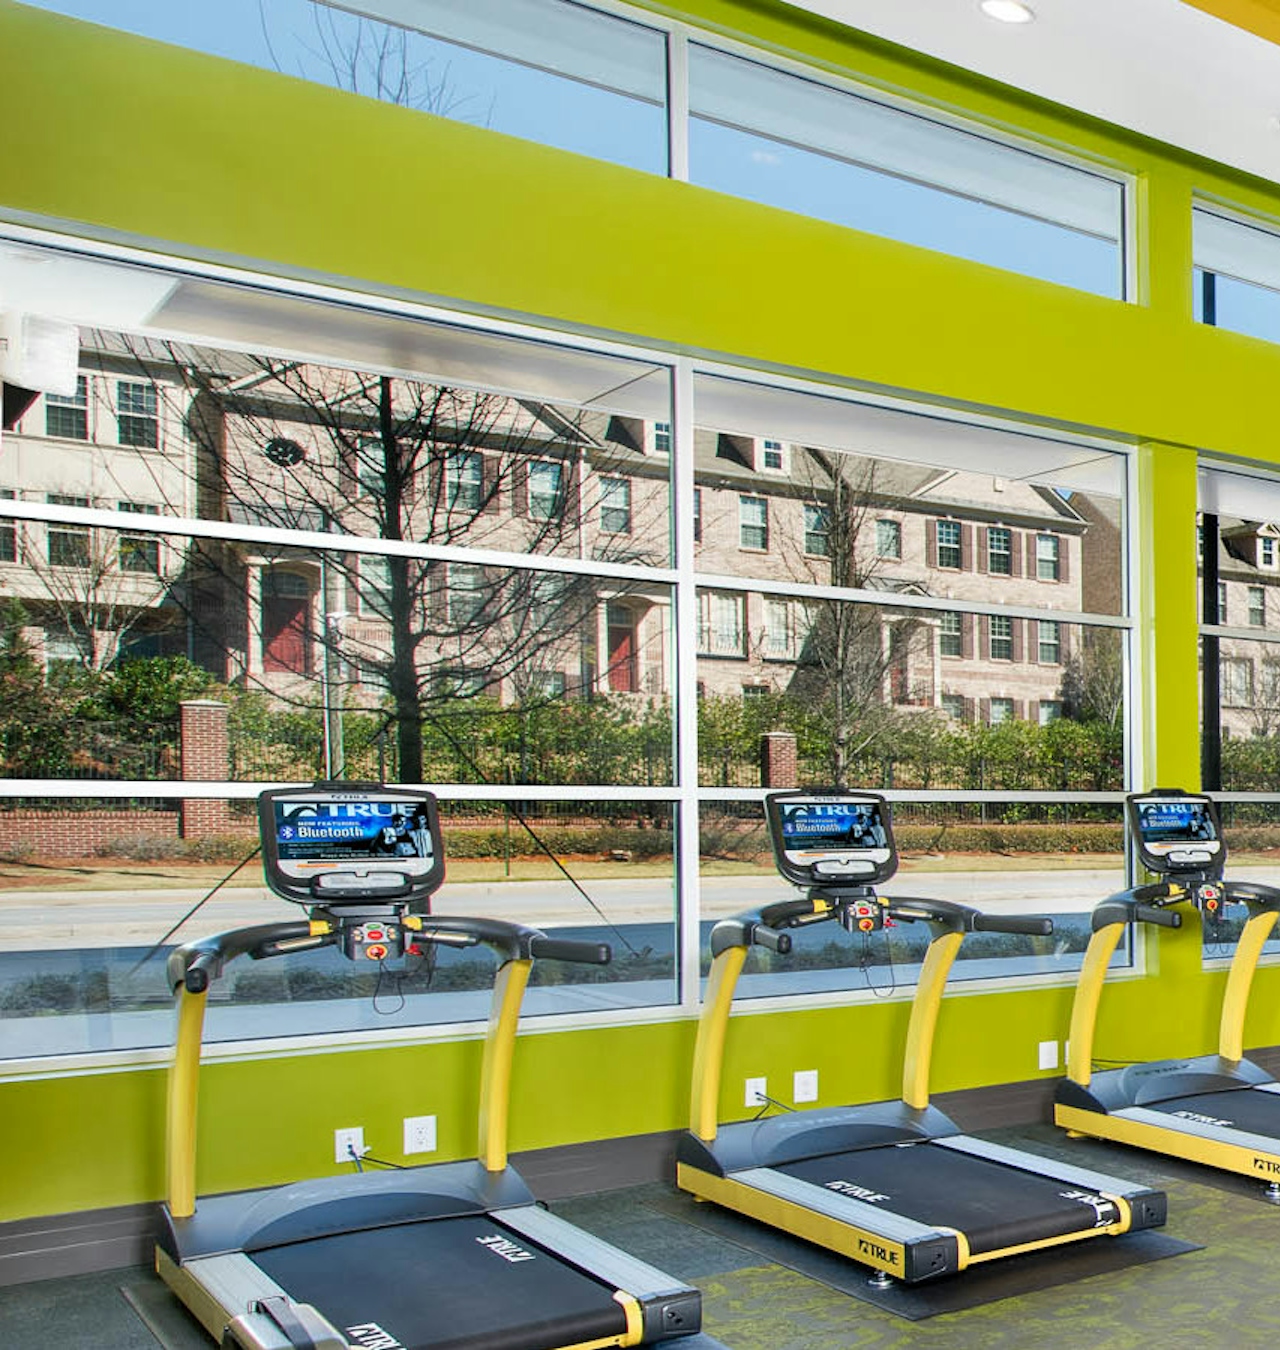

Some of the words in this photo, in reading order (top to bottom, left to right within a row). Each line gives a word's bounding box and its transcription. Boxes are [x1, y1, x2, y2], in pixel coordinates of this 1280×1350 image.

[320, 803, 418, 817] TRUE
[809, 804, 874, 816] TRUE
[298, 827, 364, 838] Bluetooth
[869, 1242, 899, 1266] TRUE
